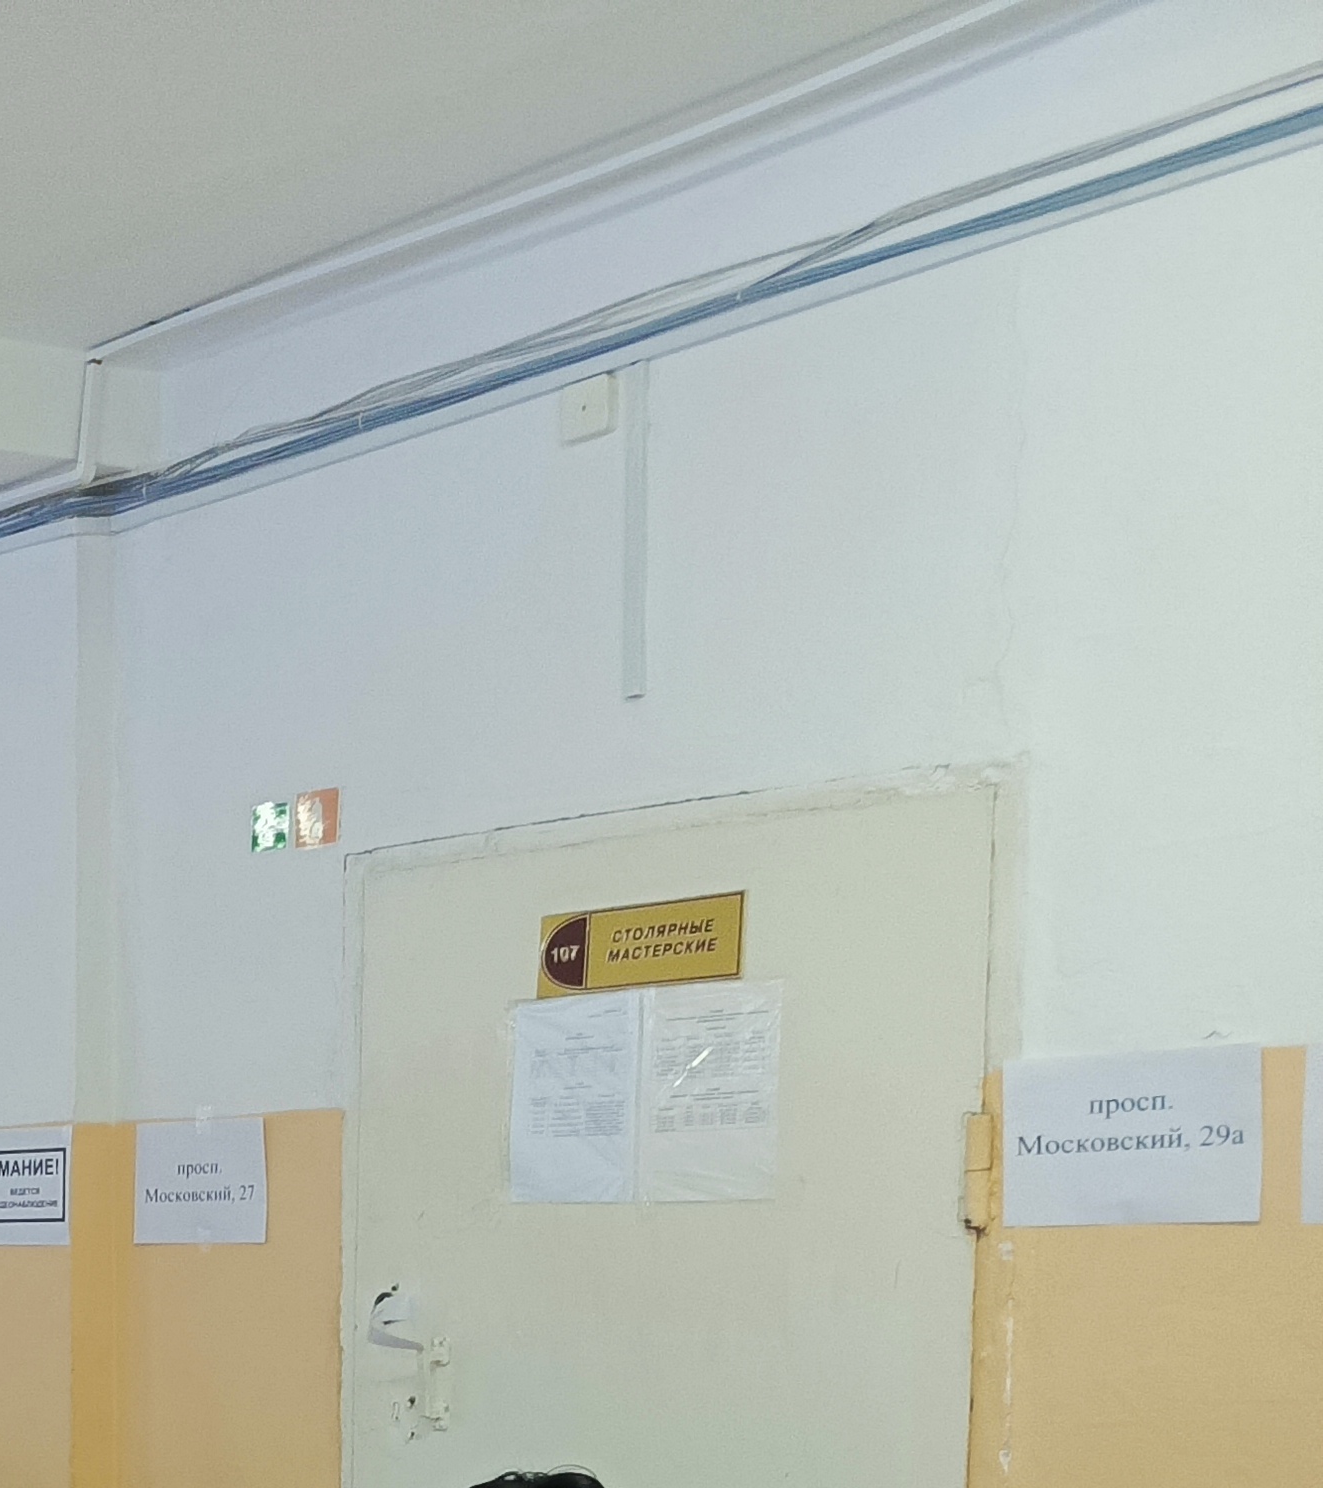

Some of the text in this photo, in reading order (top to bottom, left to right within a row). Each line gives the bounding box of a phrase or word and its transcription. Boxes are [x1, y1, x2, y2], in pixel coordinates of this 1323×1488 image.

[611, 918, 715, 943] СТОЛЯРНЫЕ
[550, 945, 581, 964] 107
[606, 937, 718, 963] МАСТЕРСКИЕ
[1088, 1094, 1174, 1119] просп.
[1016, 1124, 1245, 1157] Московский, 29а
[177, 1162, 222, 1179] просп.
[144, 1184, 255, 1204] Московский, 27
